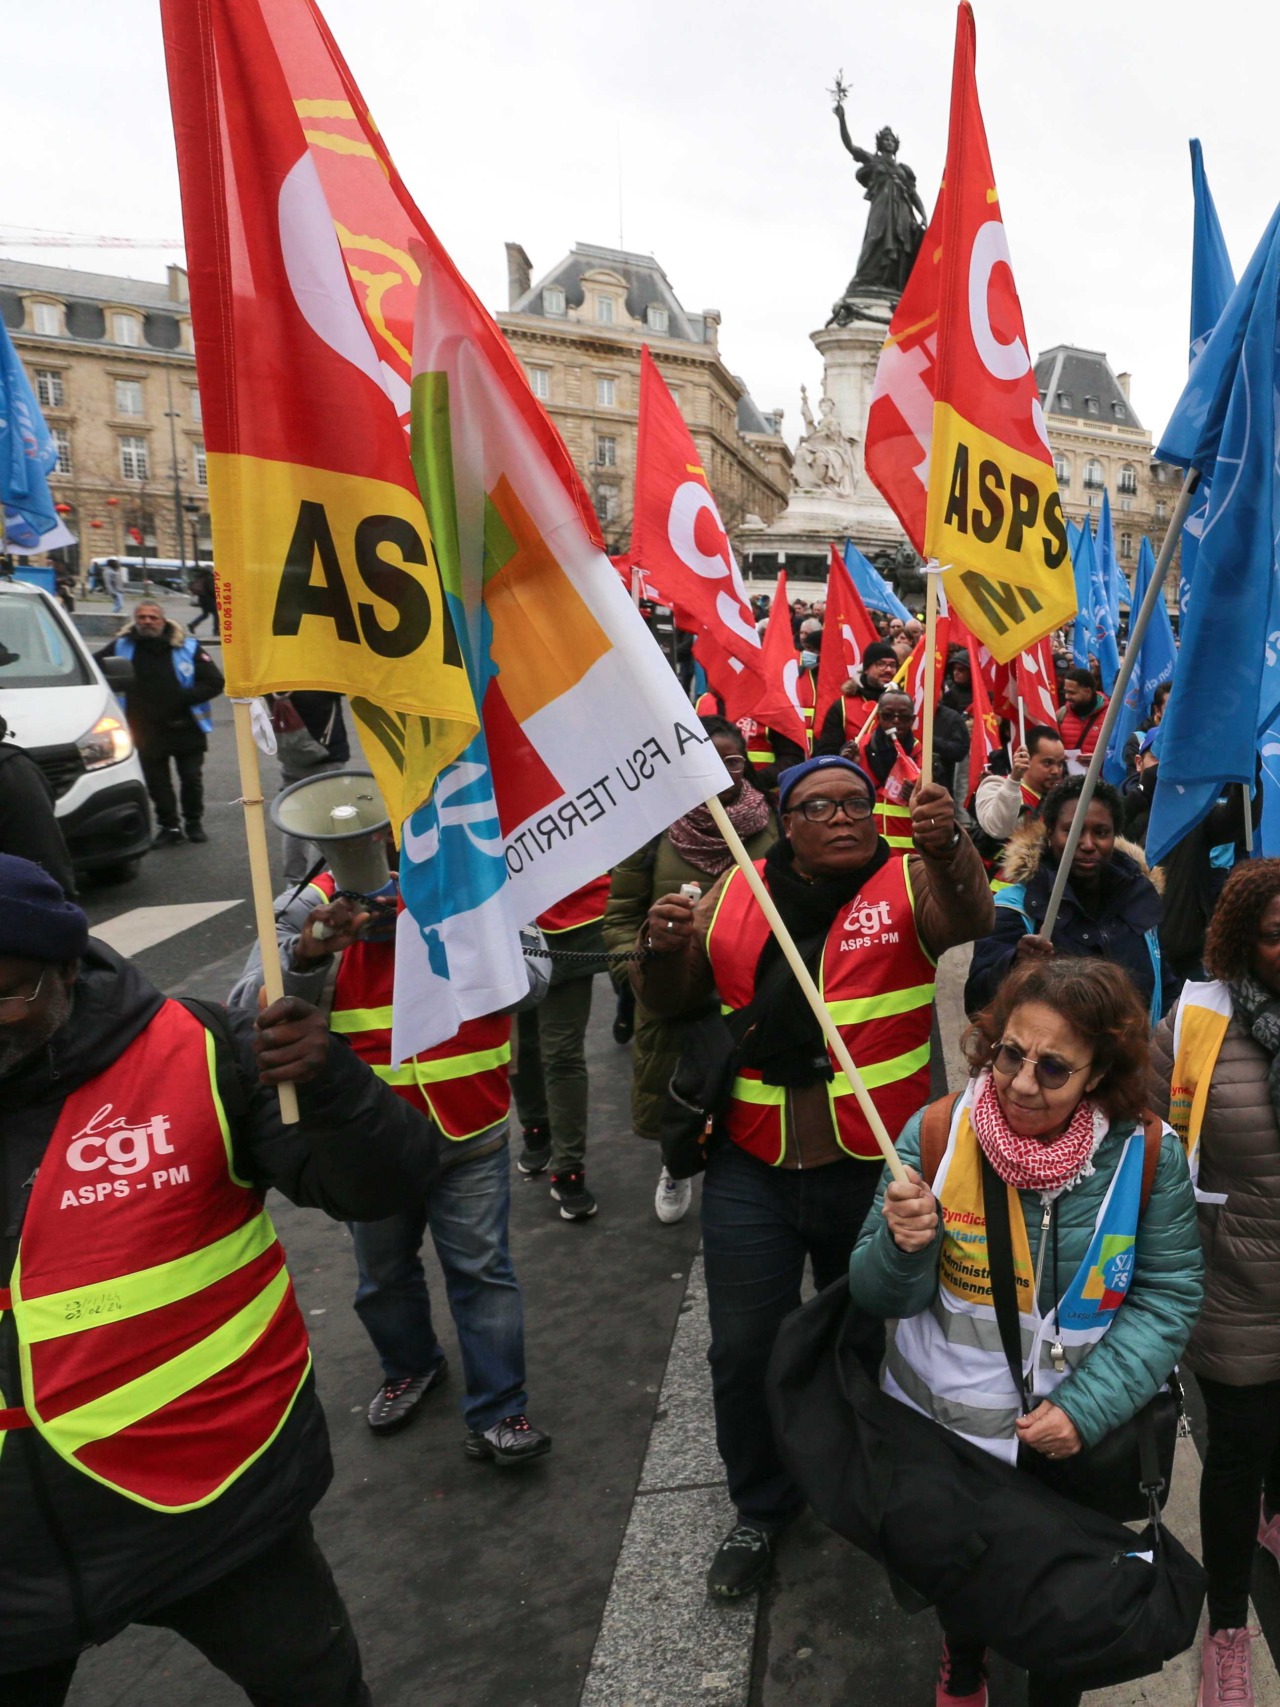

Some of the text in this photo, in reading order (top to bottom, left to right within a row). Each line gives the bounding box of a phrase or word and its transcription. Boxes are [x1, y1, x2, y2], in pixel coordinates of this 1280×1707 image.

[944, 442, 1069, 570] ASPS
[223, 582, 232, 593] 16
[223, 594, 232, 605] 16
[224, 620, 232, 631] 60
[224, 633, 232, 644] 01
[843, 901, 892, 934] cgt
[840, 937, 871, 951] ASPS
[881, 932, 899, 944] PM
[66, 1115, 174, 1175] cgt
[60, 1179, 130, 1209] ASPS
[152, 1165, 190, 1190] PM
[941, 1207, 987, 1226] Syndica
